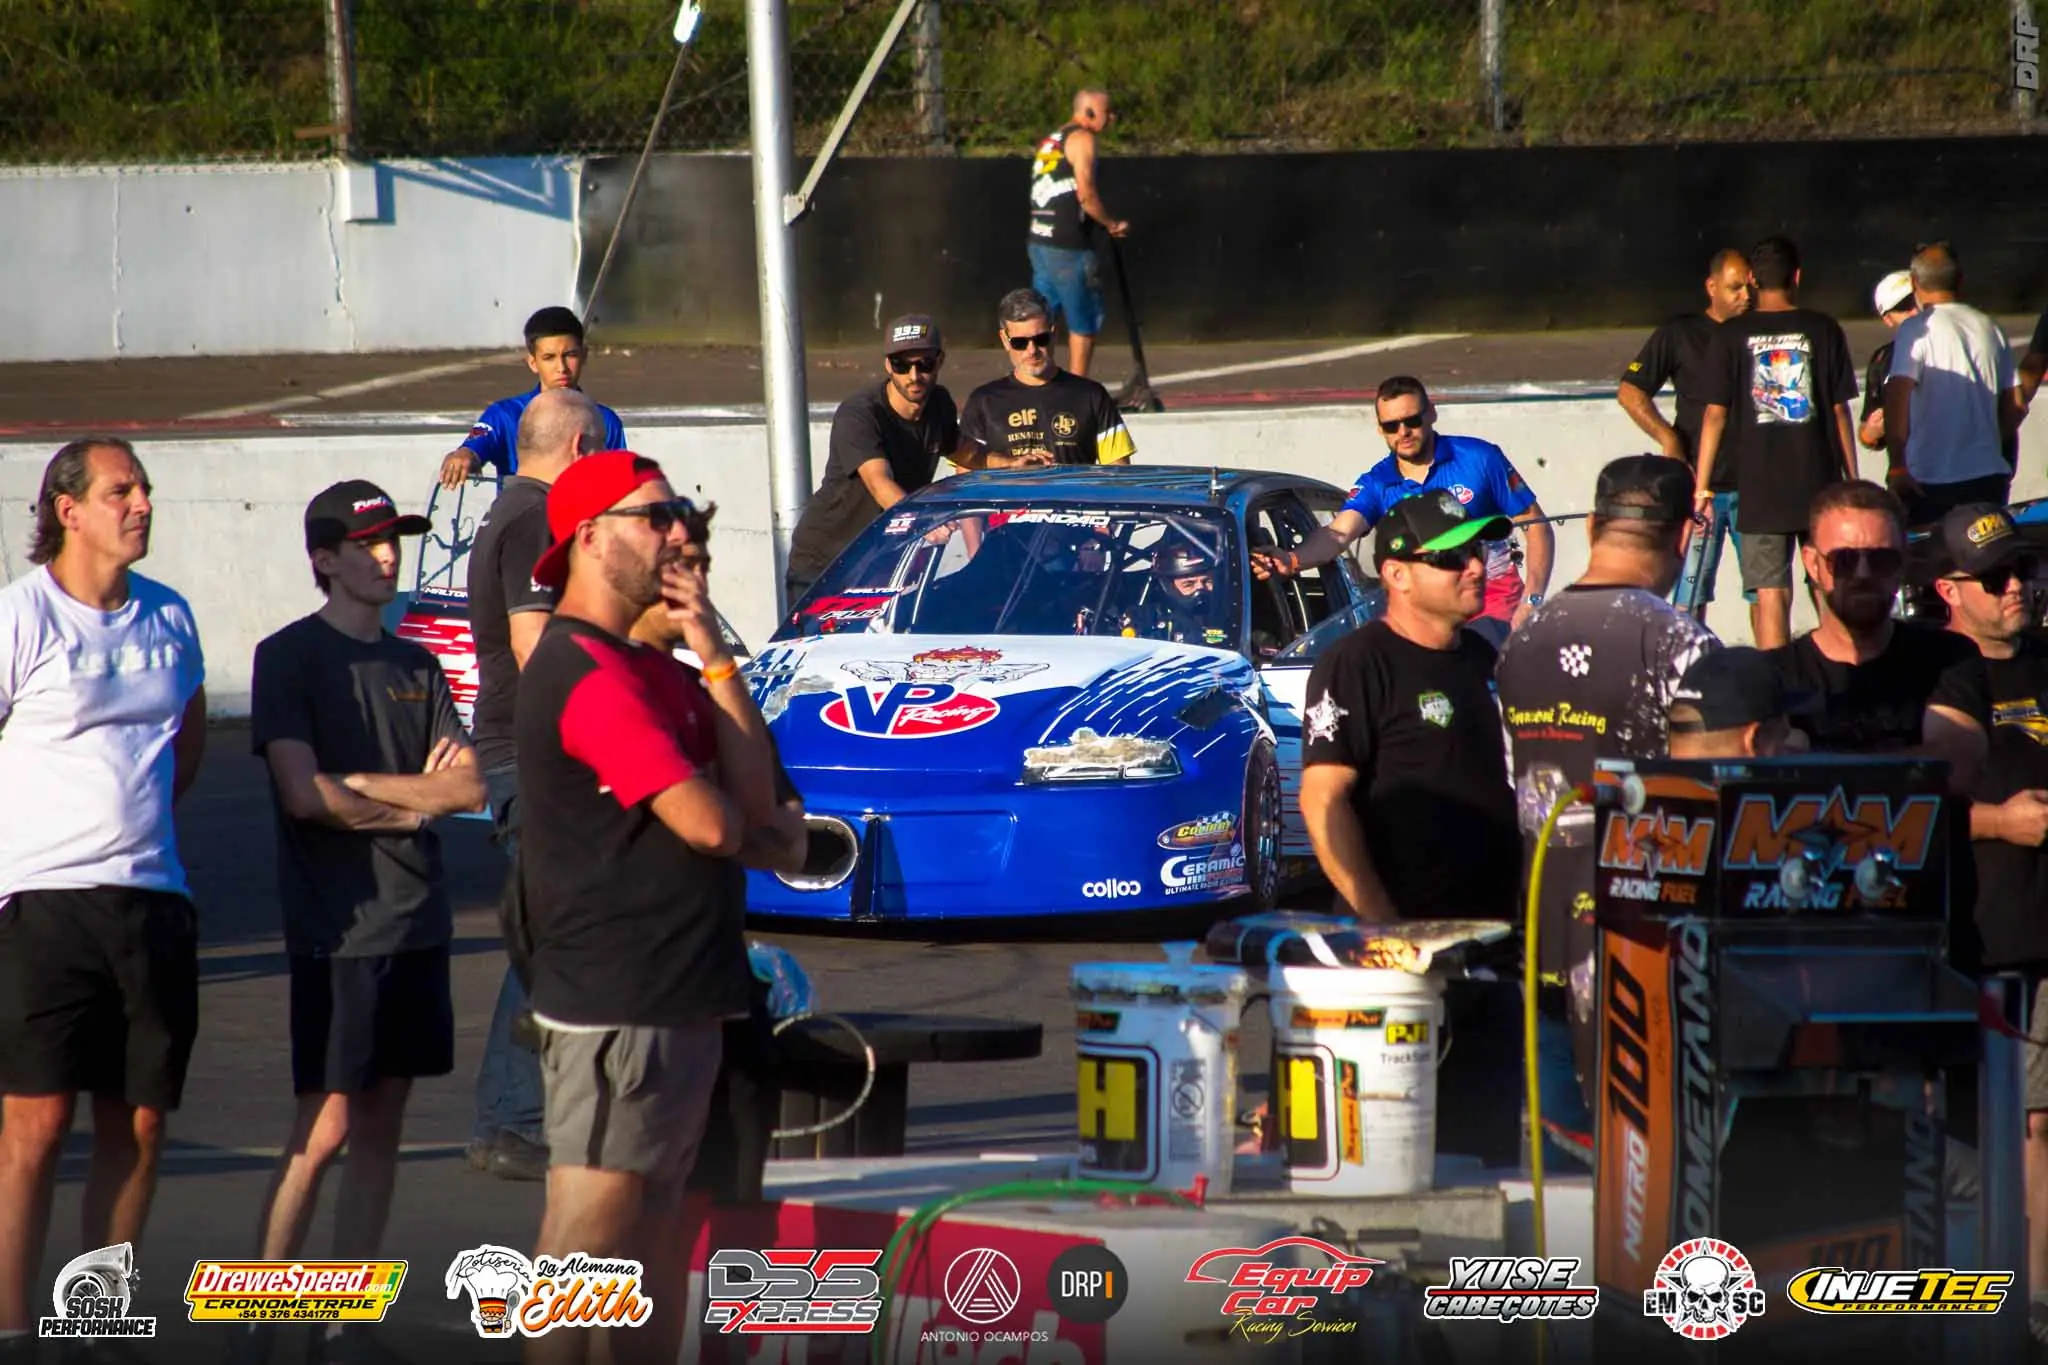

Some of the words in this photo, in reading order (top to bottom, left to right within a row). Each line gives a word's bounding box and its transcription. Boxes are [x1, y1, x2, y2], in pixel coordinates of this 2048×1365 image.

[1008, 408, 1037, 428] elf
[1008, 432, 1045, 442] RENAULT
[845, 682, 956, 735] VP
[898, 705, 998, 727] Racing
[1609, 876, 1661, 901] RACING
[1744, 882, 1844, 909] RANG
[1608, 954, 1650, 1135] 100
[1624, 1129, 1648, 1261] NITRO
